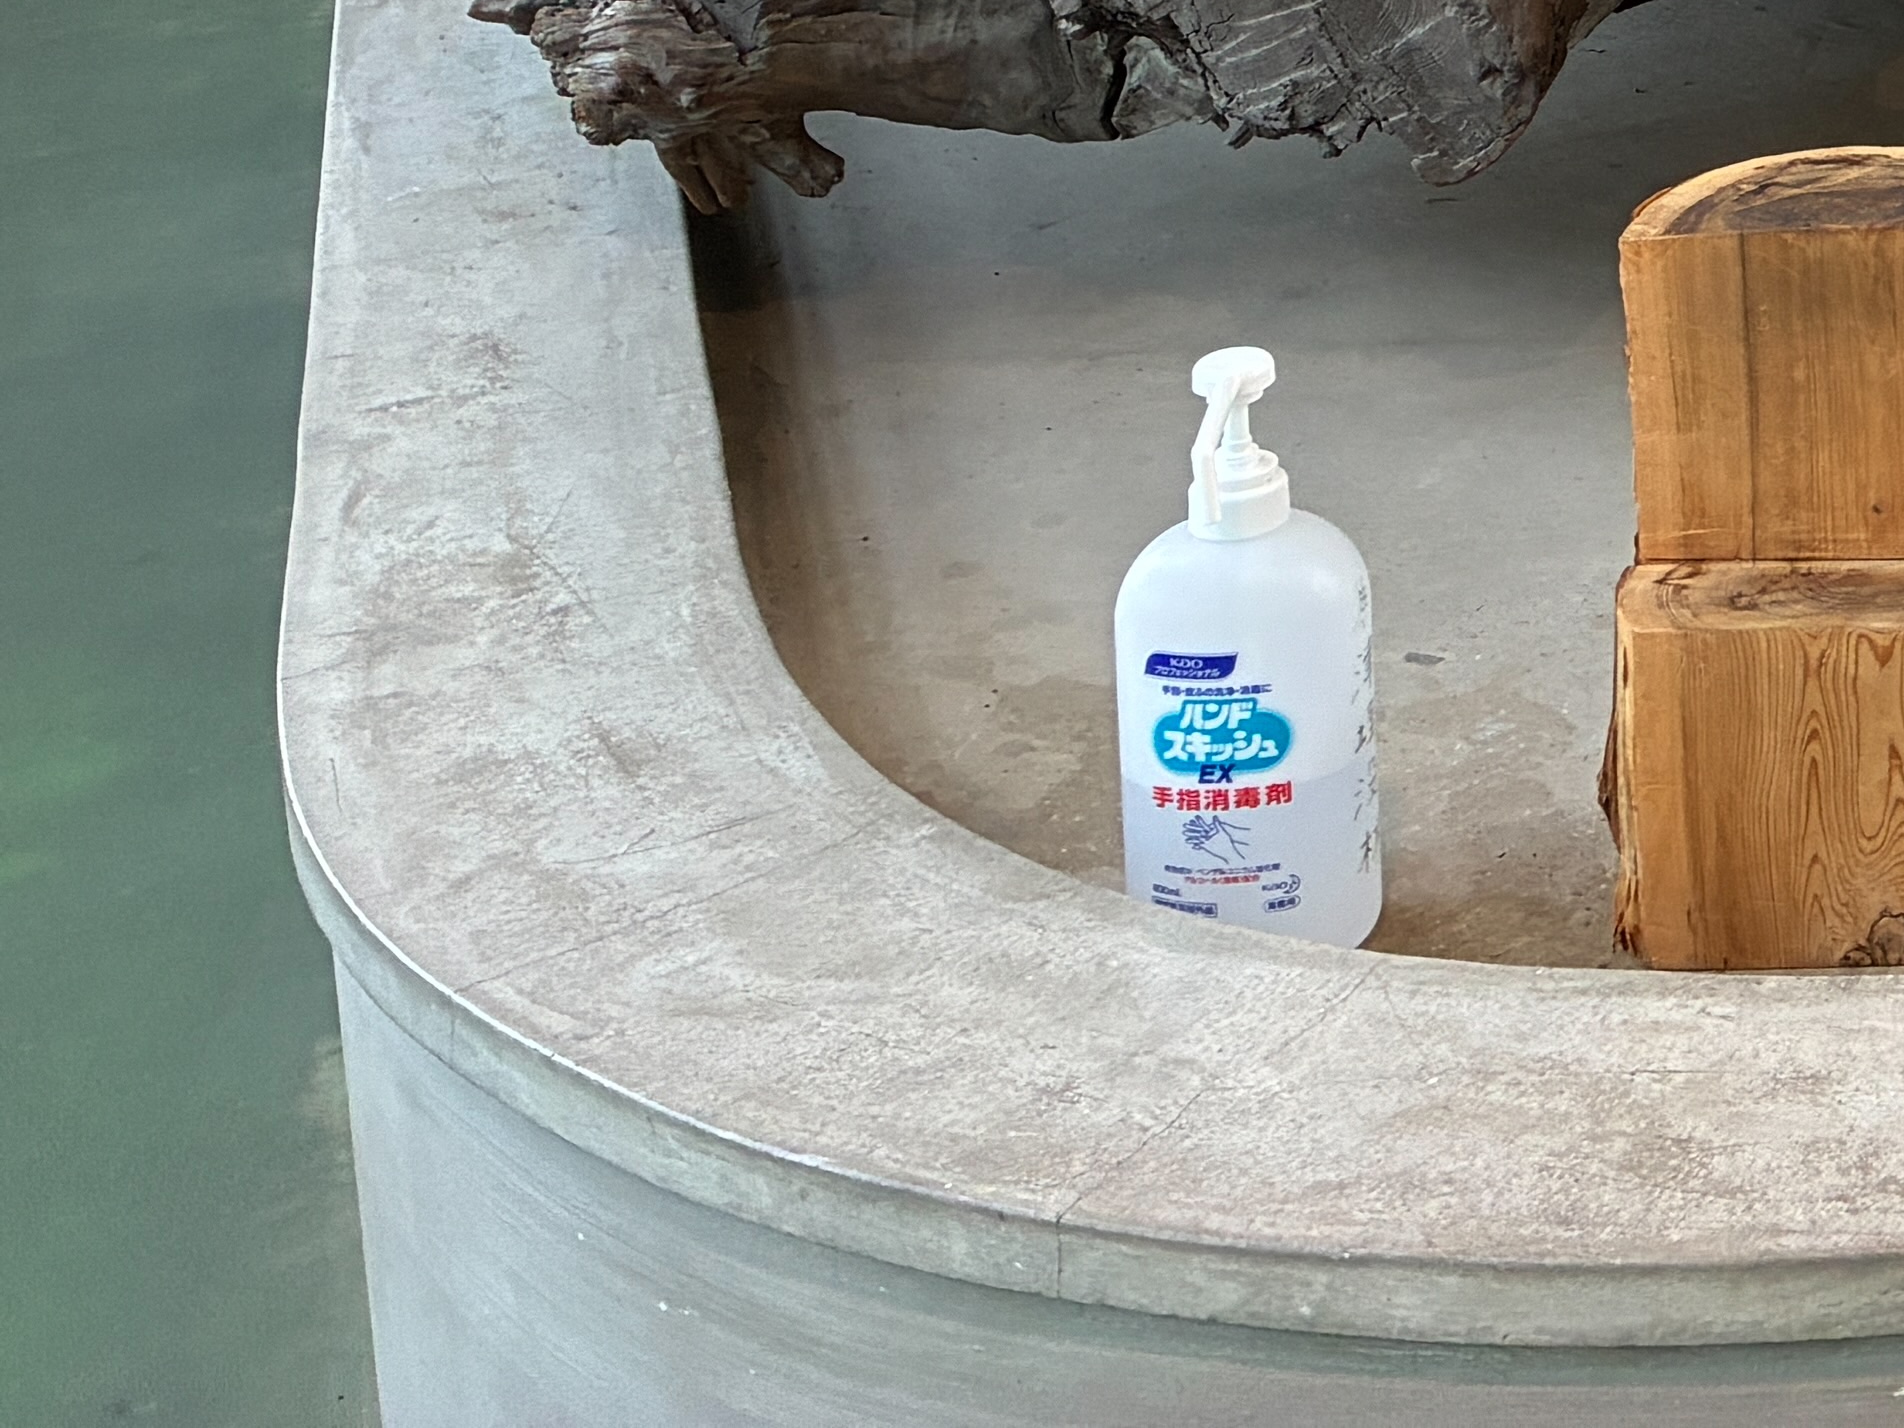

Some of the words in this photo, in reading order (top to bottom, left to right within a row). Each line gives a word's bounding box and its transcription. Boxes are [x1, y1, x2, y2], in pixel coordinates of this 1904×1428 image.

[1179, 700, 1254, 730] ハンド
[1162, 730, 1279, 763] スキッシュ
[1198, 764, 1236, 784] EX
[1152, 781, 1294, 813] 手指消毒剤
